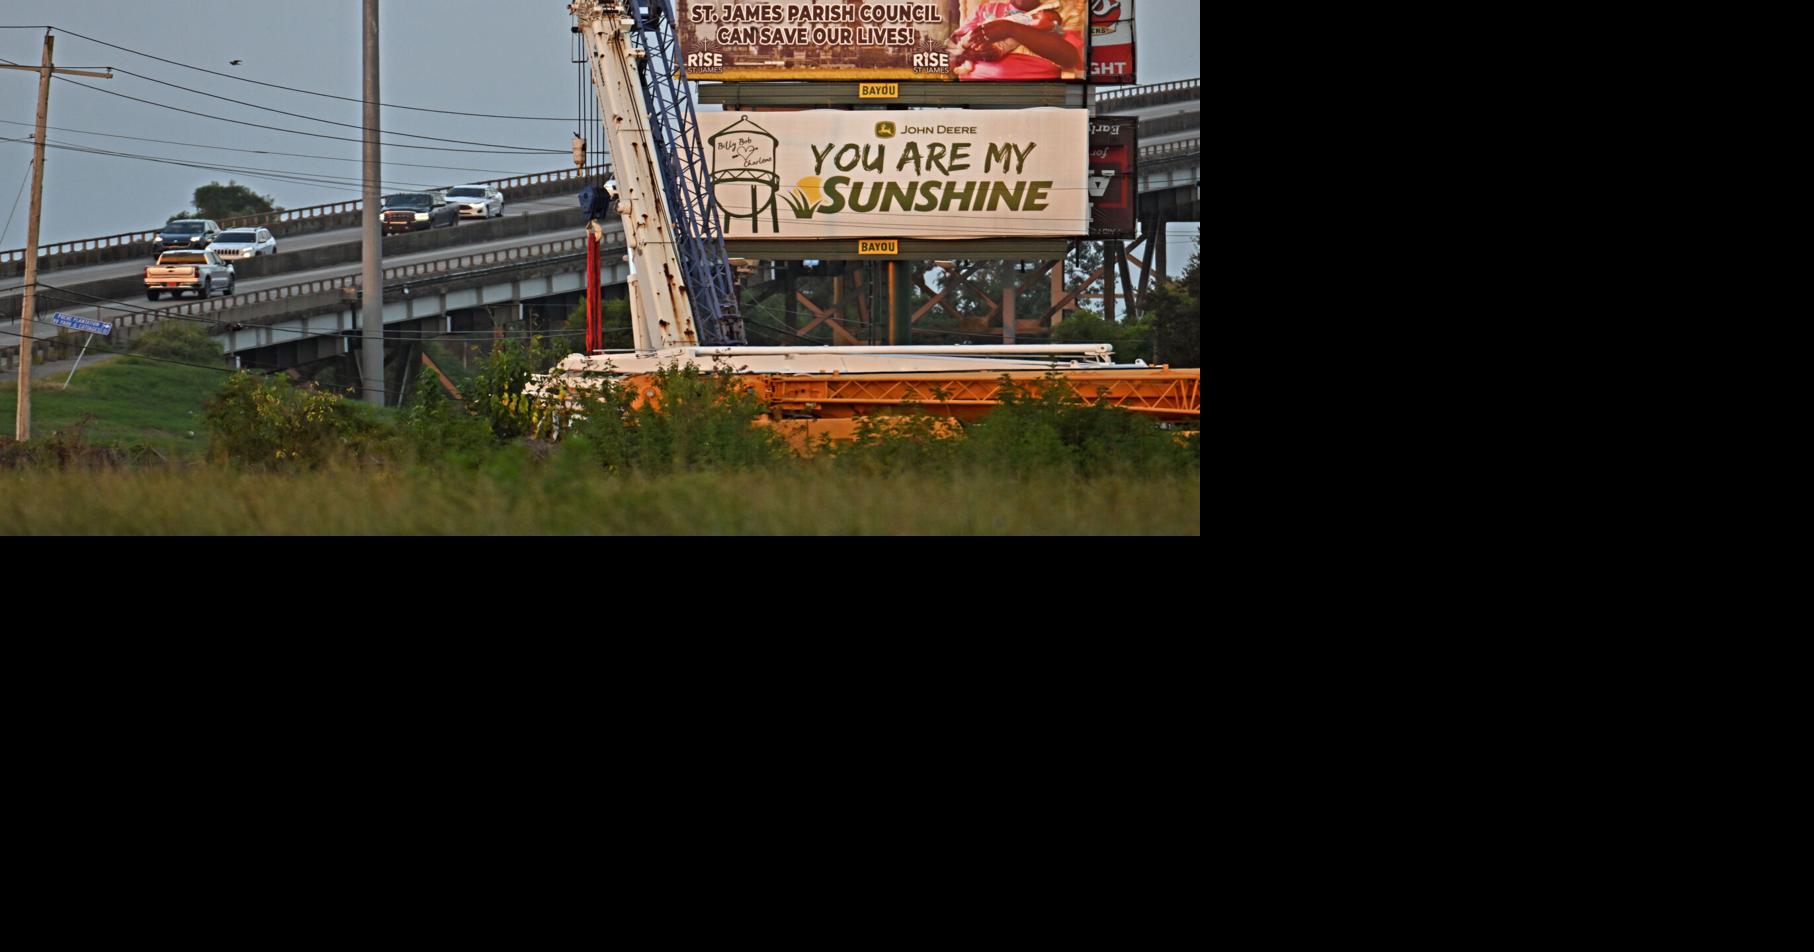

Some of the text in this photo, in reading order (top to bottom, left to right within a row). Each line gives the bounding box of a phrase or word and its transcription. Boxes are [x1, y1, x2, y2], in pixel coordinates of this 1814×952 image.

[692, 4, 942, 23] ST. JAMES PARISH COUNCIL
[717, 27, 915, 45] CAN SAVE OUR LIVES!
[1090, 62, 1127, 75] GHT
[862, 85, 896, 96] BAYOU
[900, 125, 977, 135] JOHN DEERE
[717, 136, 752, 152] Billy Bob
[811, 141, 1037, 176] YOU ARE MY
[817, 176, 1054, 214] SUNSHINE
[861, 242, 895, 254] BAYOU
